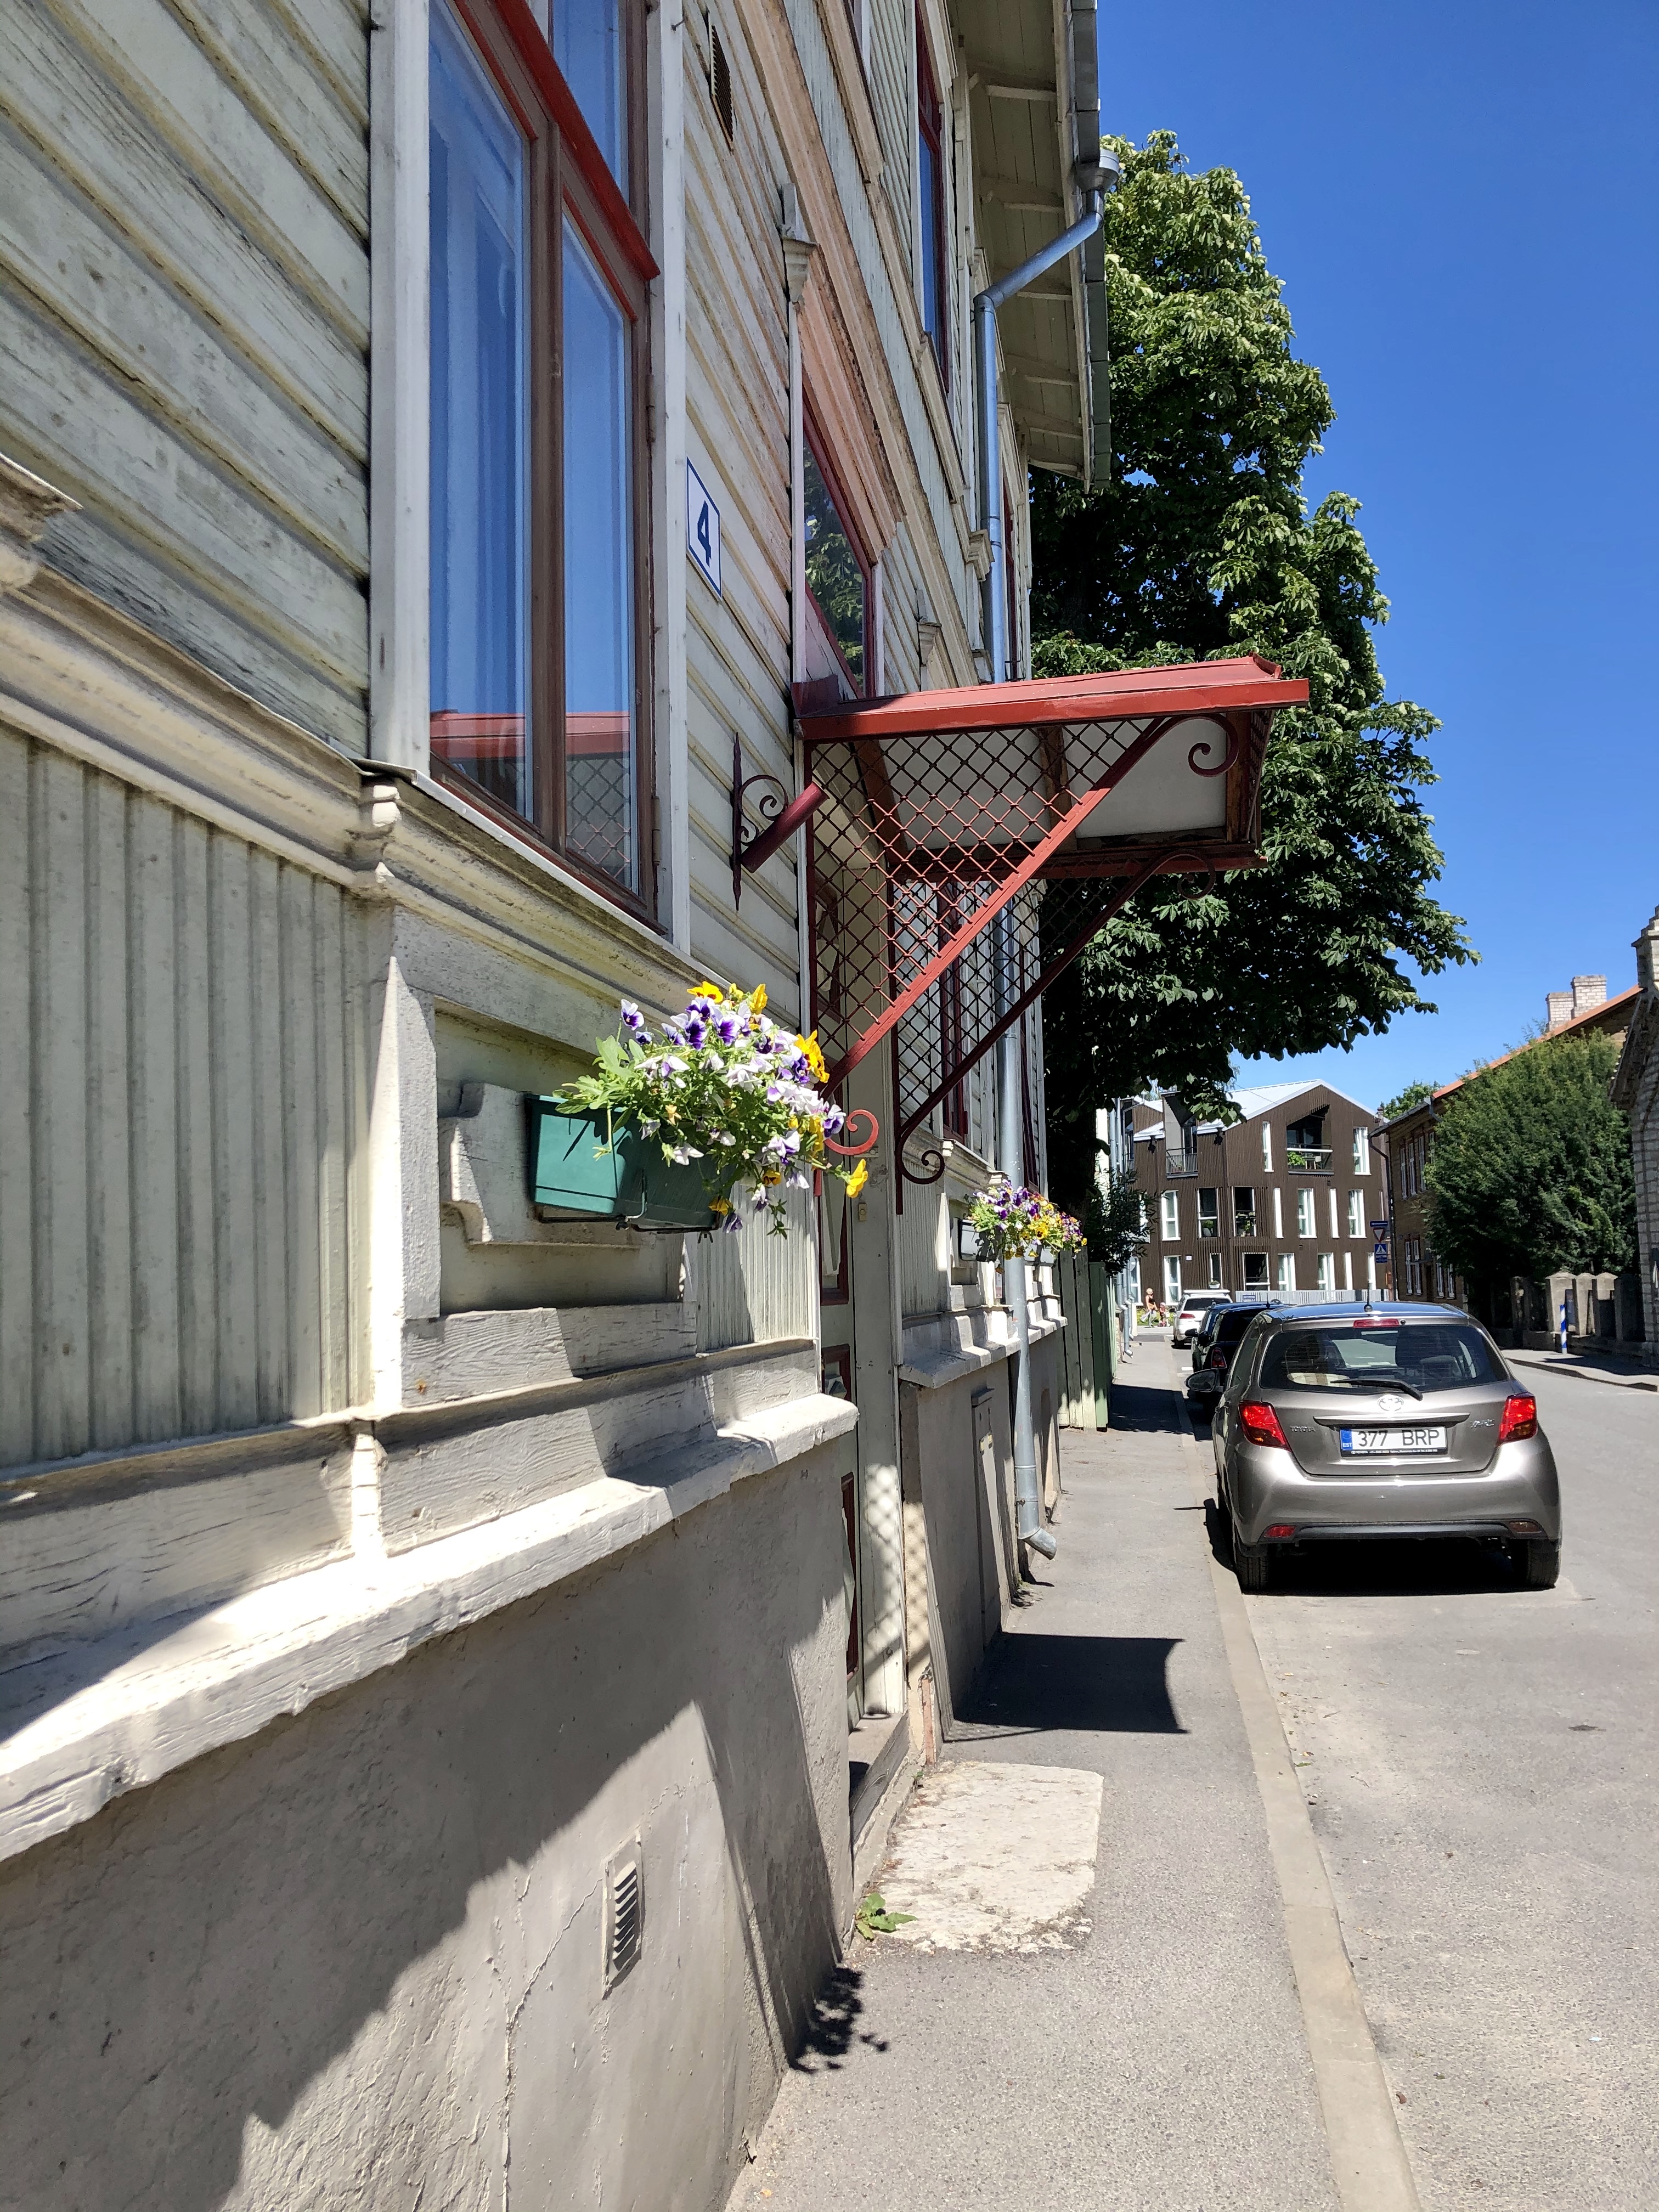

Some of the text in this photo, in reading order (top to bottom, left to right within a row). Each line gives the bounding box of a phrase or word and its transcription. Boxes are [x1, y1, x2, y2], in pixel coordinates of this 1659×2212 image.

[697, 500, 712, 567] 4
[1358, 1429, 1440, 1447] 377 BRP
